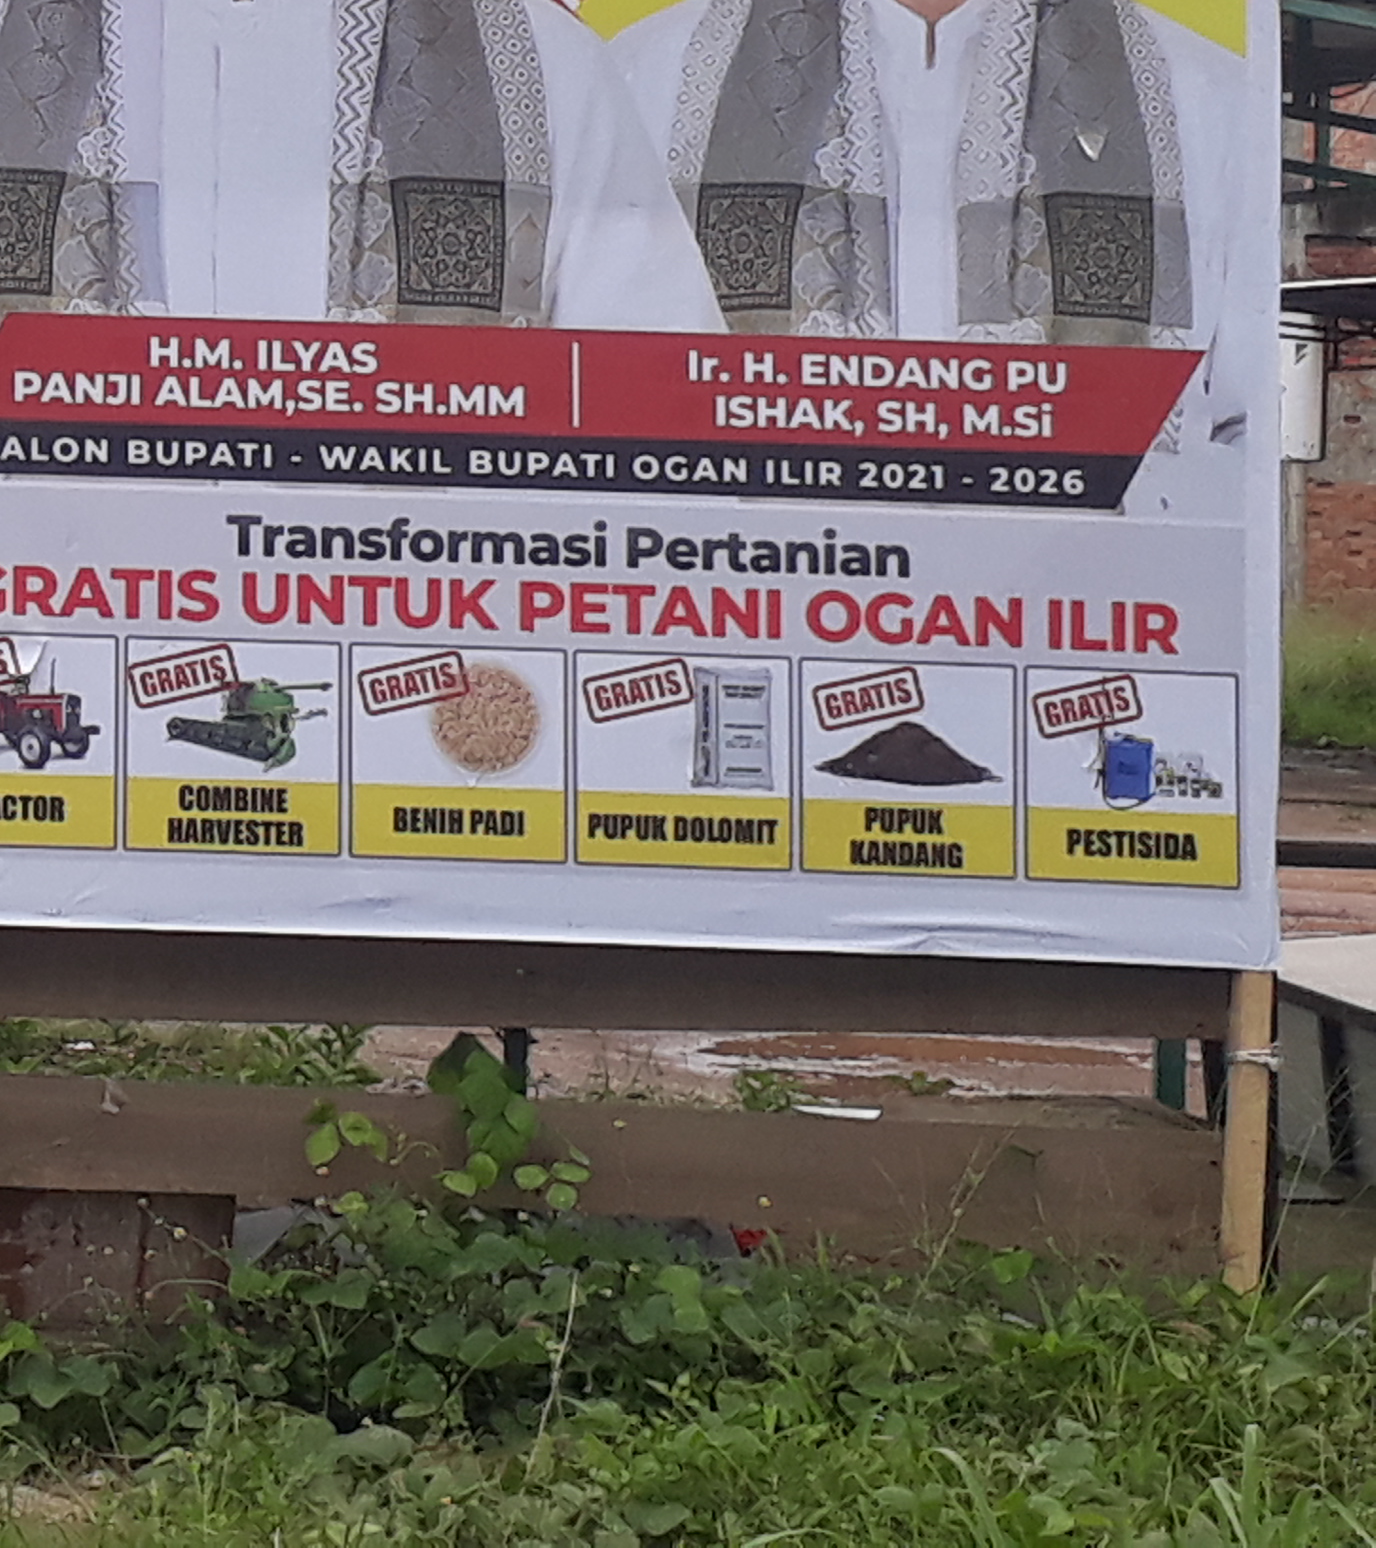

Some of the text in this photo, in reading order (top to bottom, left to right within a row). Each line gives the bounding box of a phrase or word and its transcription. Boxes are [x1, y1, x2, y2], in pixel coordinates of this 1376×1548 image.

[149, 336, 378, 374] H.M. ILYAS
[688, 350, 1068, 393] Ir. H. ENDANG PU
[13, 372, 527, 417] PANJI ALAM,SE. SH.MM
[715, 395, 1053, 438] ISHAK, SH, M.Si
[126, 439, 274, 468] BUPATI
[319, 444, 453, 474] WAKIL
[467, 448, 615, 479] BUPATI
[632, 453, 748, 483] OGAN
[765, 458, 842, 486] ILIR
[858, 461, 945, 490] 2021
[990, 465, 1086, 496] 2026
[227, 515, 911, 578] Transformasi Pertanian
[241, 571, 497, 632] UNTUK
[517, 582, 783, 640] PETANI
[804, 590, 1024, 649] OGAN
[1048, 599, 1179, 655] ILIR
[138, 655, 230, 698] GRATIS
[367, 662, 459, 705] GRATIS
[594, 671, 684, 712] GRATIS
[822, 678, 914, 721] GRATIS
[1042, 686, 1132, 729] GRATIS
[178, 785, 289, 814] COMBINE
[864, 807, 944, 835] PUPUK
[167, 817, 304, 849] HARVESTER
[392, 806, 525, 837] BENIH PADI
[587, 814, 779, 845] PUPUK DOLOMIT
[850, 840, 964, 869] KANDANG
[1066, 828, 1198, 861] PESTISIDA
